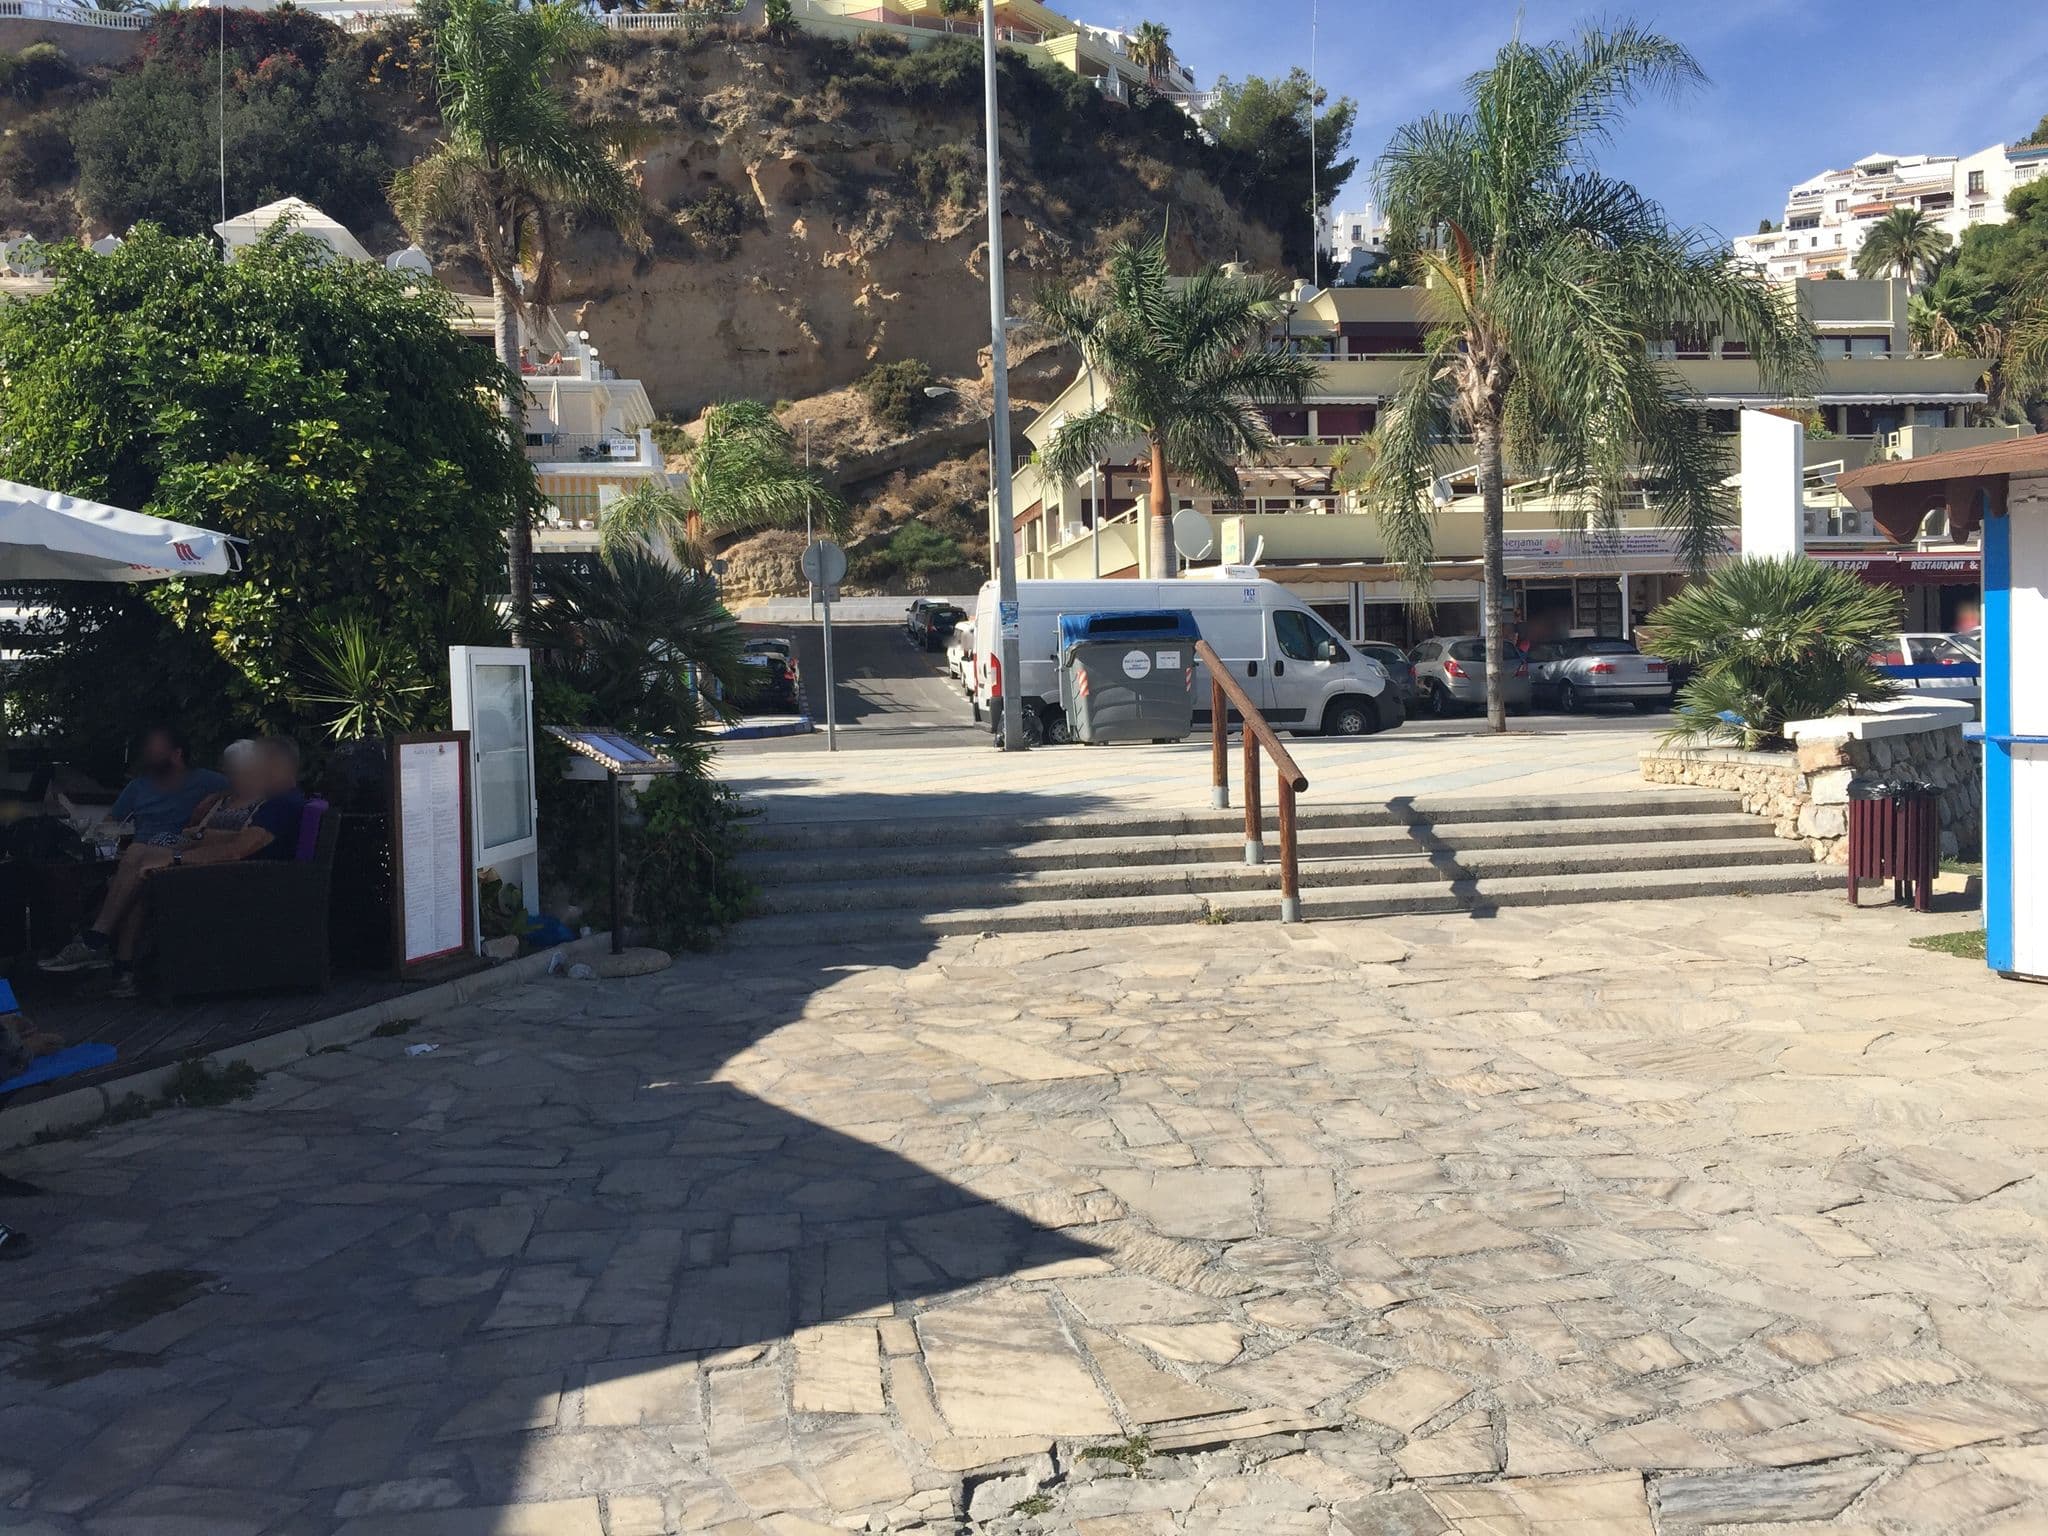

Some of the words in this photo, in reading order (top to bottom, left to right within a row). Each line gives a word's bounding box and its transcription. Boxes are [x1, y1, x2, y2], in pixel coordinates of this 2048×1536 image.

[1837, 560, 1870, 570] BEACH
[1910, 560, 1965, 571] RESTAURANT
[1969, 560, 1979, 570] &
